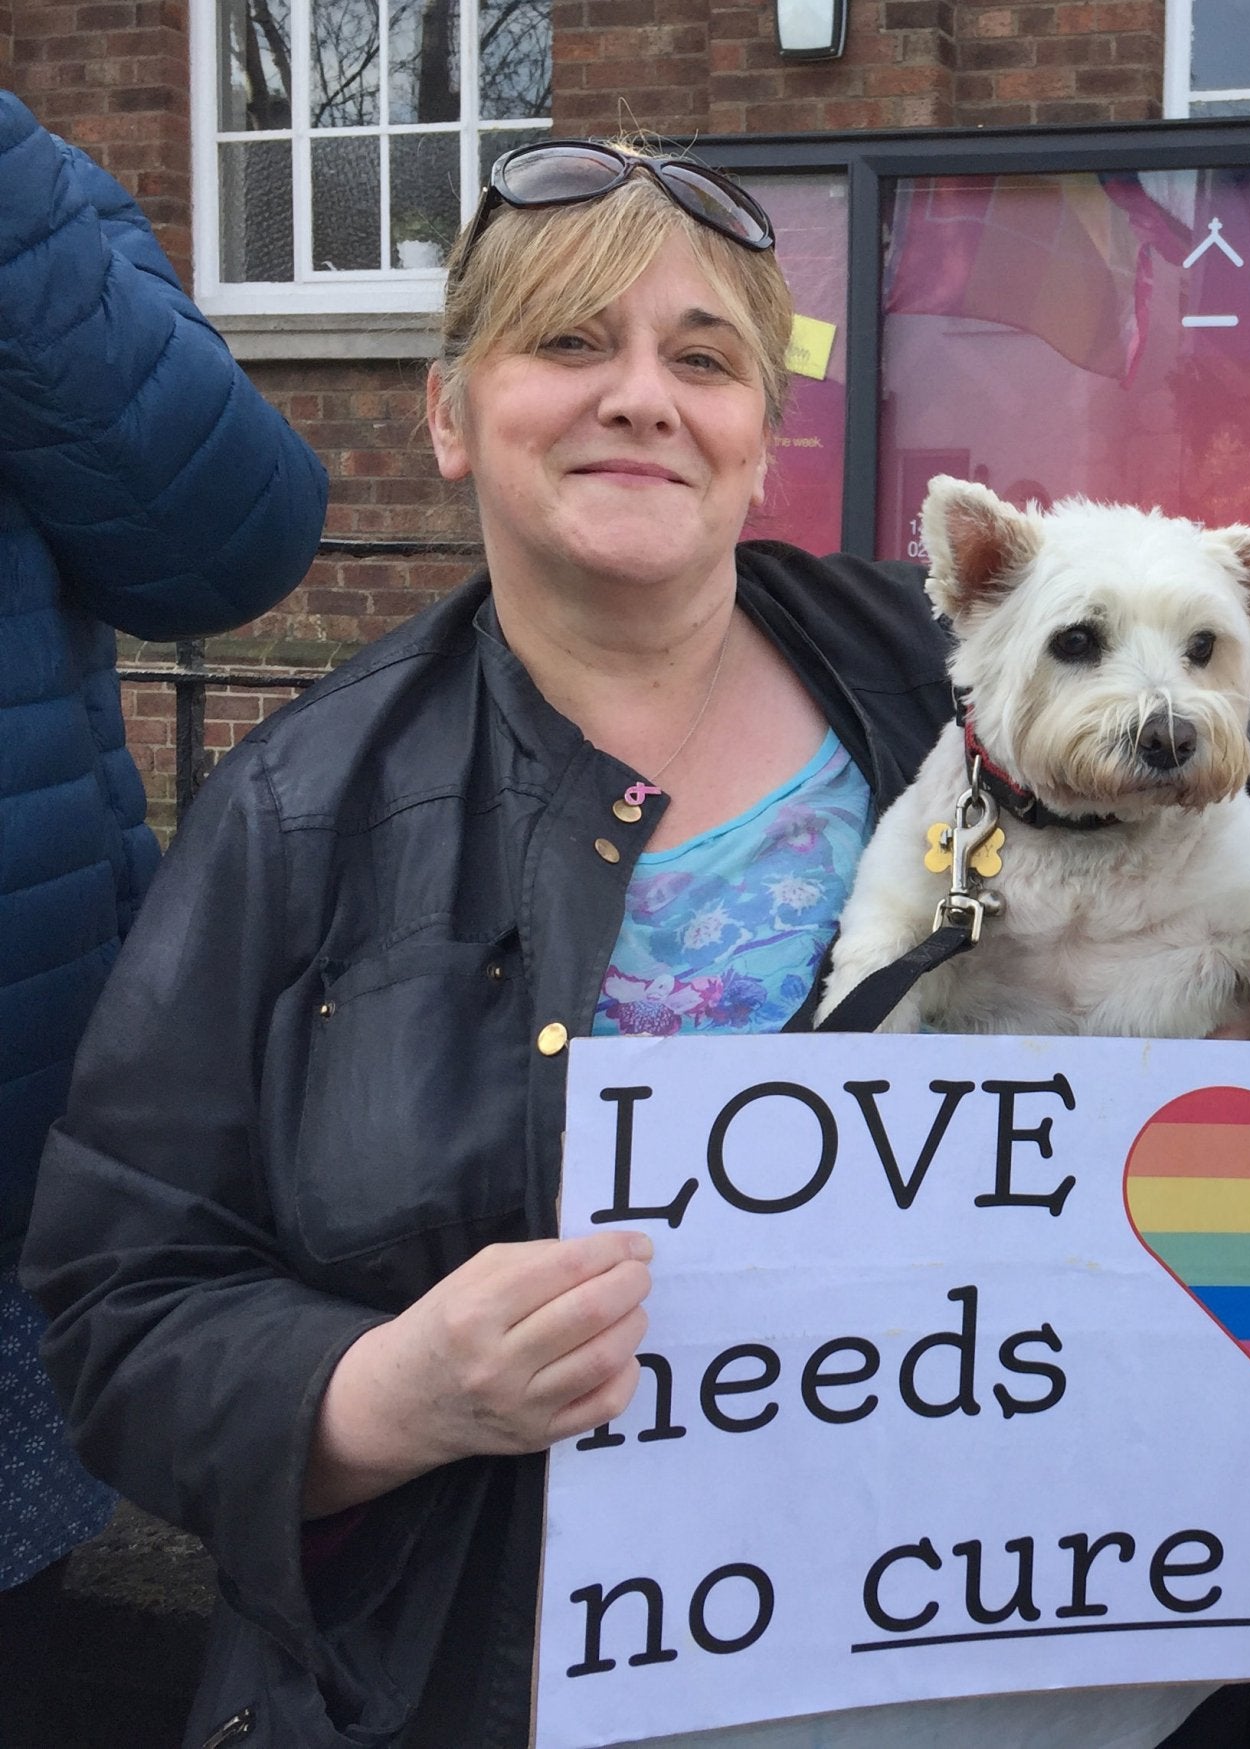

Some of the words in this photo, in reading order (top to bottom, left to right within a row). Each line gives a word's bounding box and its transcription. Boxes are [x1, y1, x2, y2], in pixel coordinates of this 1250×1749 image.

[591, 1072, 1077, 1230] LOVE
[575, 1285, 1067, 1452] needs
[566, 1562, 776, 1678] no
[863, 1524, 1226, 1632] cure
